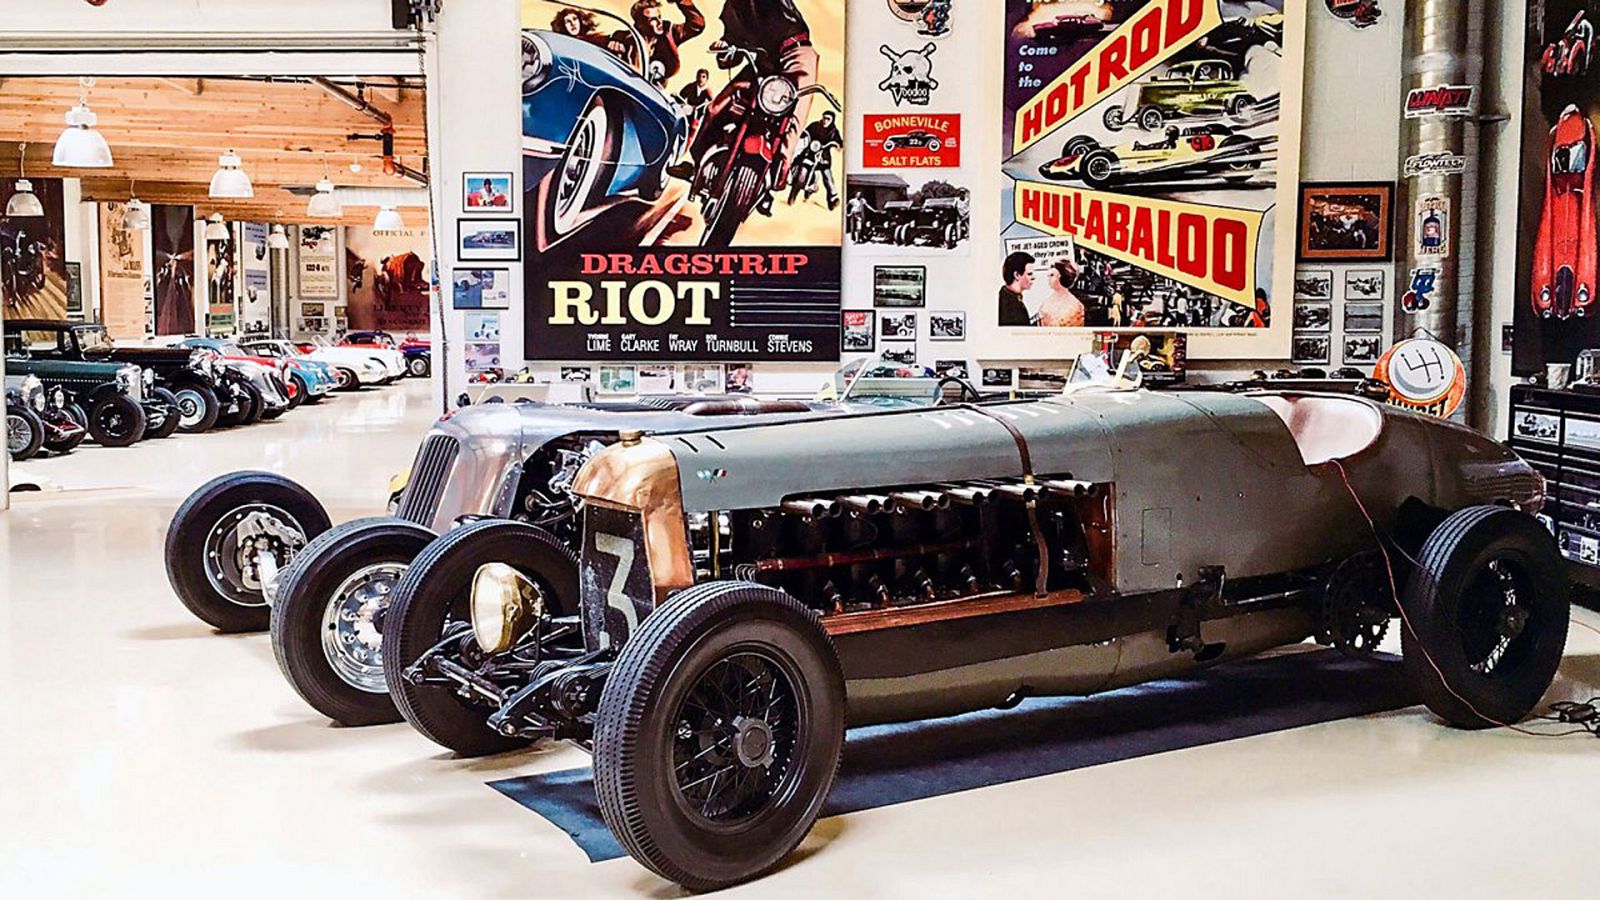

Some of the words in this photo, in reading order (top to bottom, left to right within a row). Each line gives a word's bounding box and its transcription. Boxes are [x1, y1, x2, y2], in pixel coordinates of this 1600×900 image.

[1018, 44, 1057, 56] Come
[1018, 61, 1033, 72] to
[1022, 60, 1092, 144] HOT
[1097, 0, 1203, 94] ROD
[1018, 76, 1041, 88] the
[874, 116, 950, 133] BONNEVILLE
[882, 157, 906, 166] SALT
[910, 156, 941, 166] FLATS
[1022, 189, 1248, 292] HULLABALOO
[1049, 240, 1068, 248] CROWD
[581, 254, 808, 275] DRAGSTRIP
[548, 280, 720, 325] RIOT
[587, 339, 611, 352] LIME
[620, 340, 660, 352] CLARKE
[669, 340, 698, 352] WRAY
[706, 340, 759, 352] TURNBULL
[767, 340, 813, 352] STEVENS
[595, 531, 639, 651] 3
